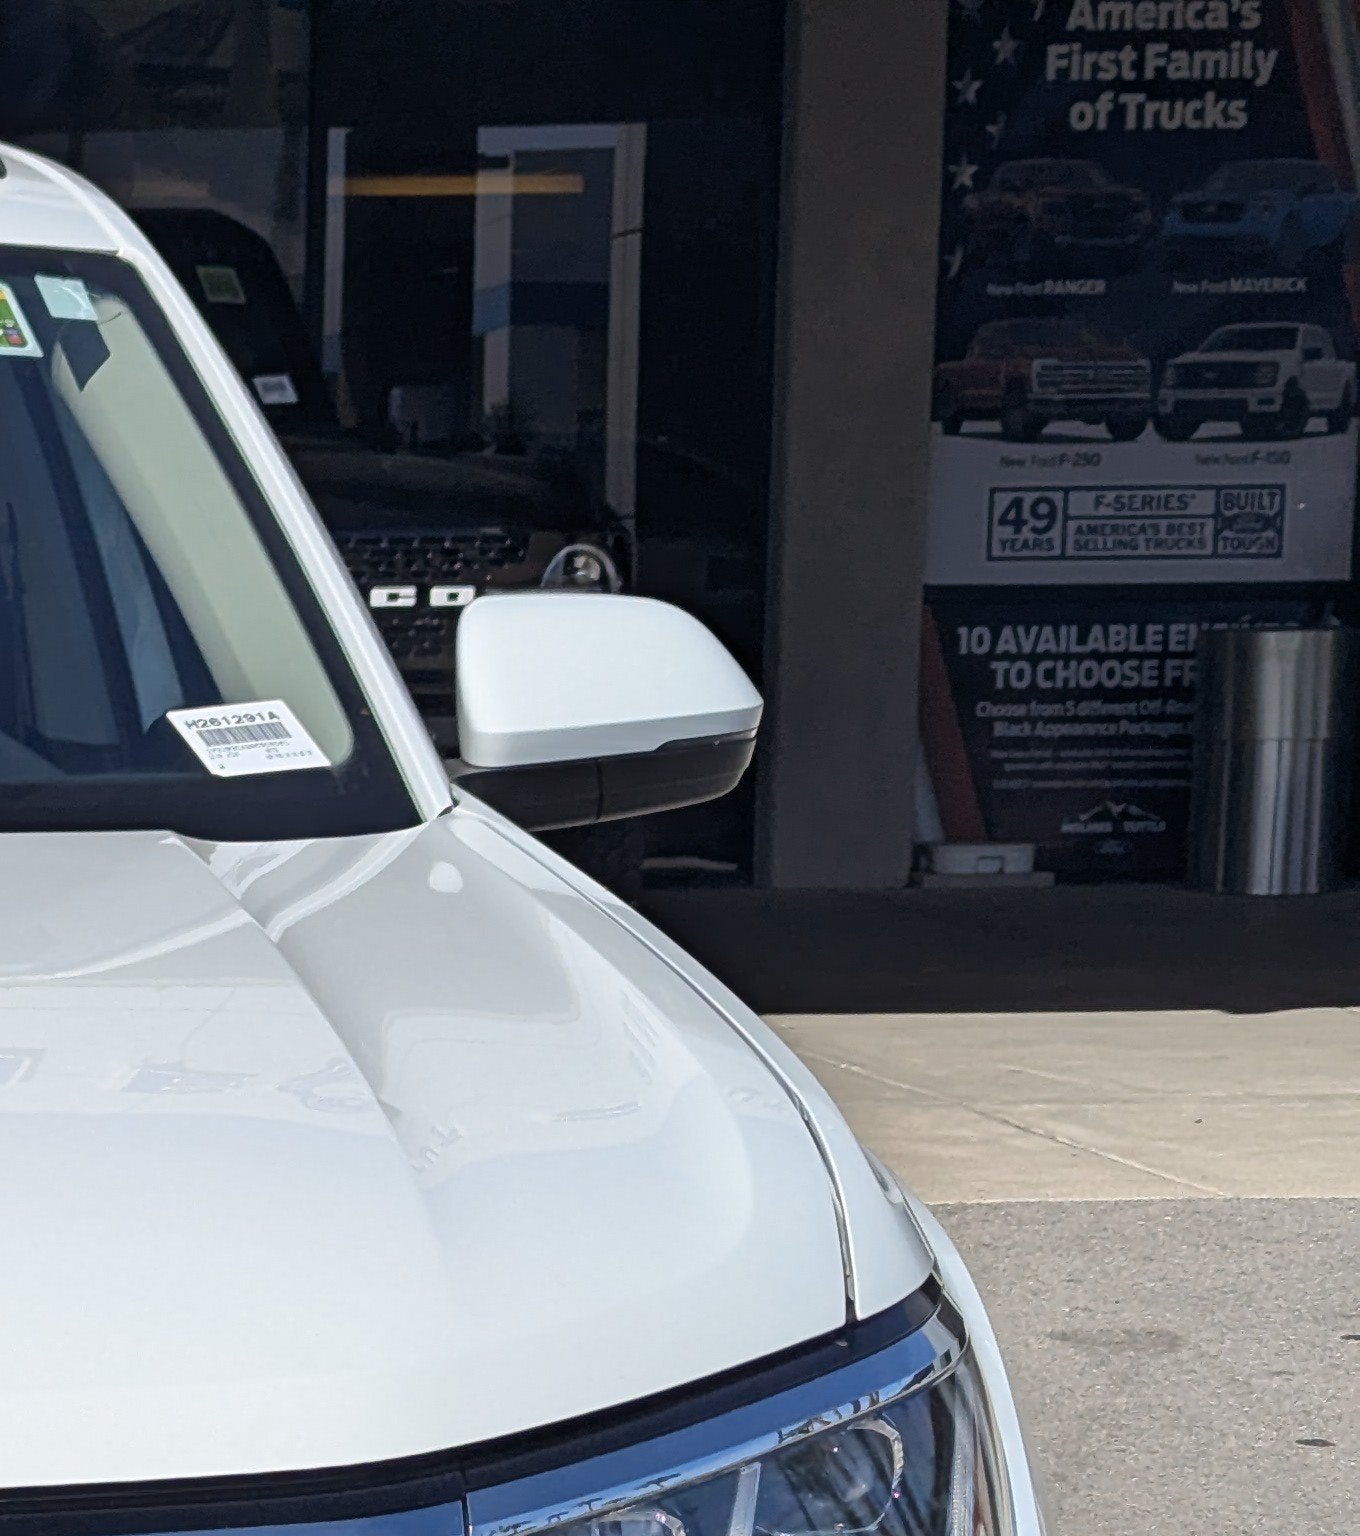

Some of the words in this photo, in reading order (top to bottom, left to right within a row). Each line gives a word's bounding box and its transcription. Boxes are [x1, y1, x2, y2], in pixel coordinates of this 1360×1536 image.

[1046, 42, 1138, 81] First
[1144, 40, 1279, 87] Family
[1069, 90, 1115, 131] of
[1118, 91, 1248, 130] Trucks
[997, 495, 1058, 535] 49
[1223, 490, 1278, 511] BUILT
[998, 537, 1055, 553] YEARS
[957, 626, 991, 656] 10
[995, 623, 1163, 656] AVAILABLE
[992, 661, 1031, 690] TO
[1036, 660, 1160, 689] CHOOSE
